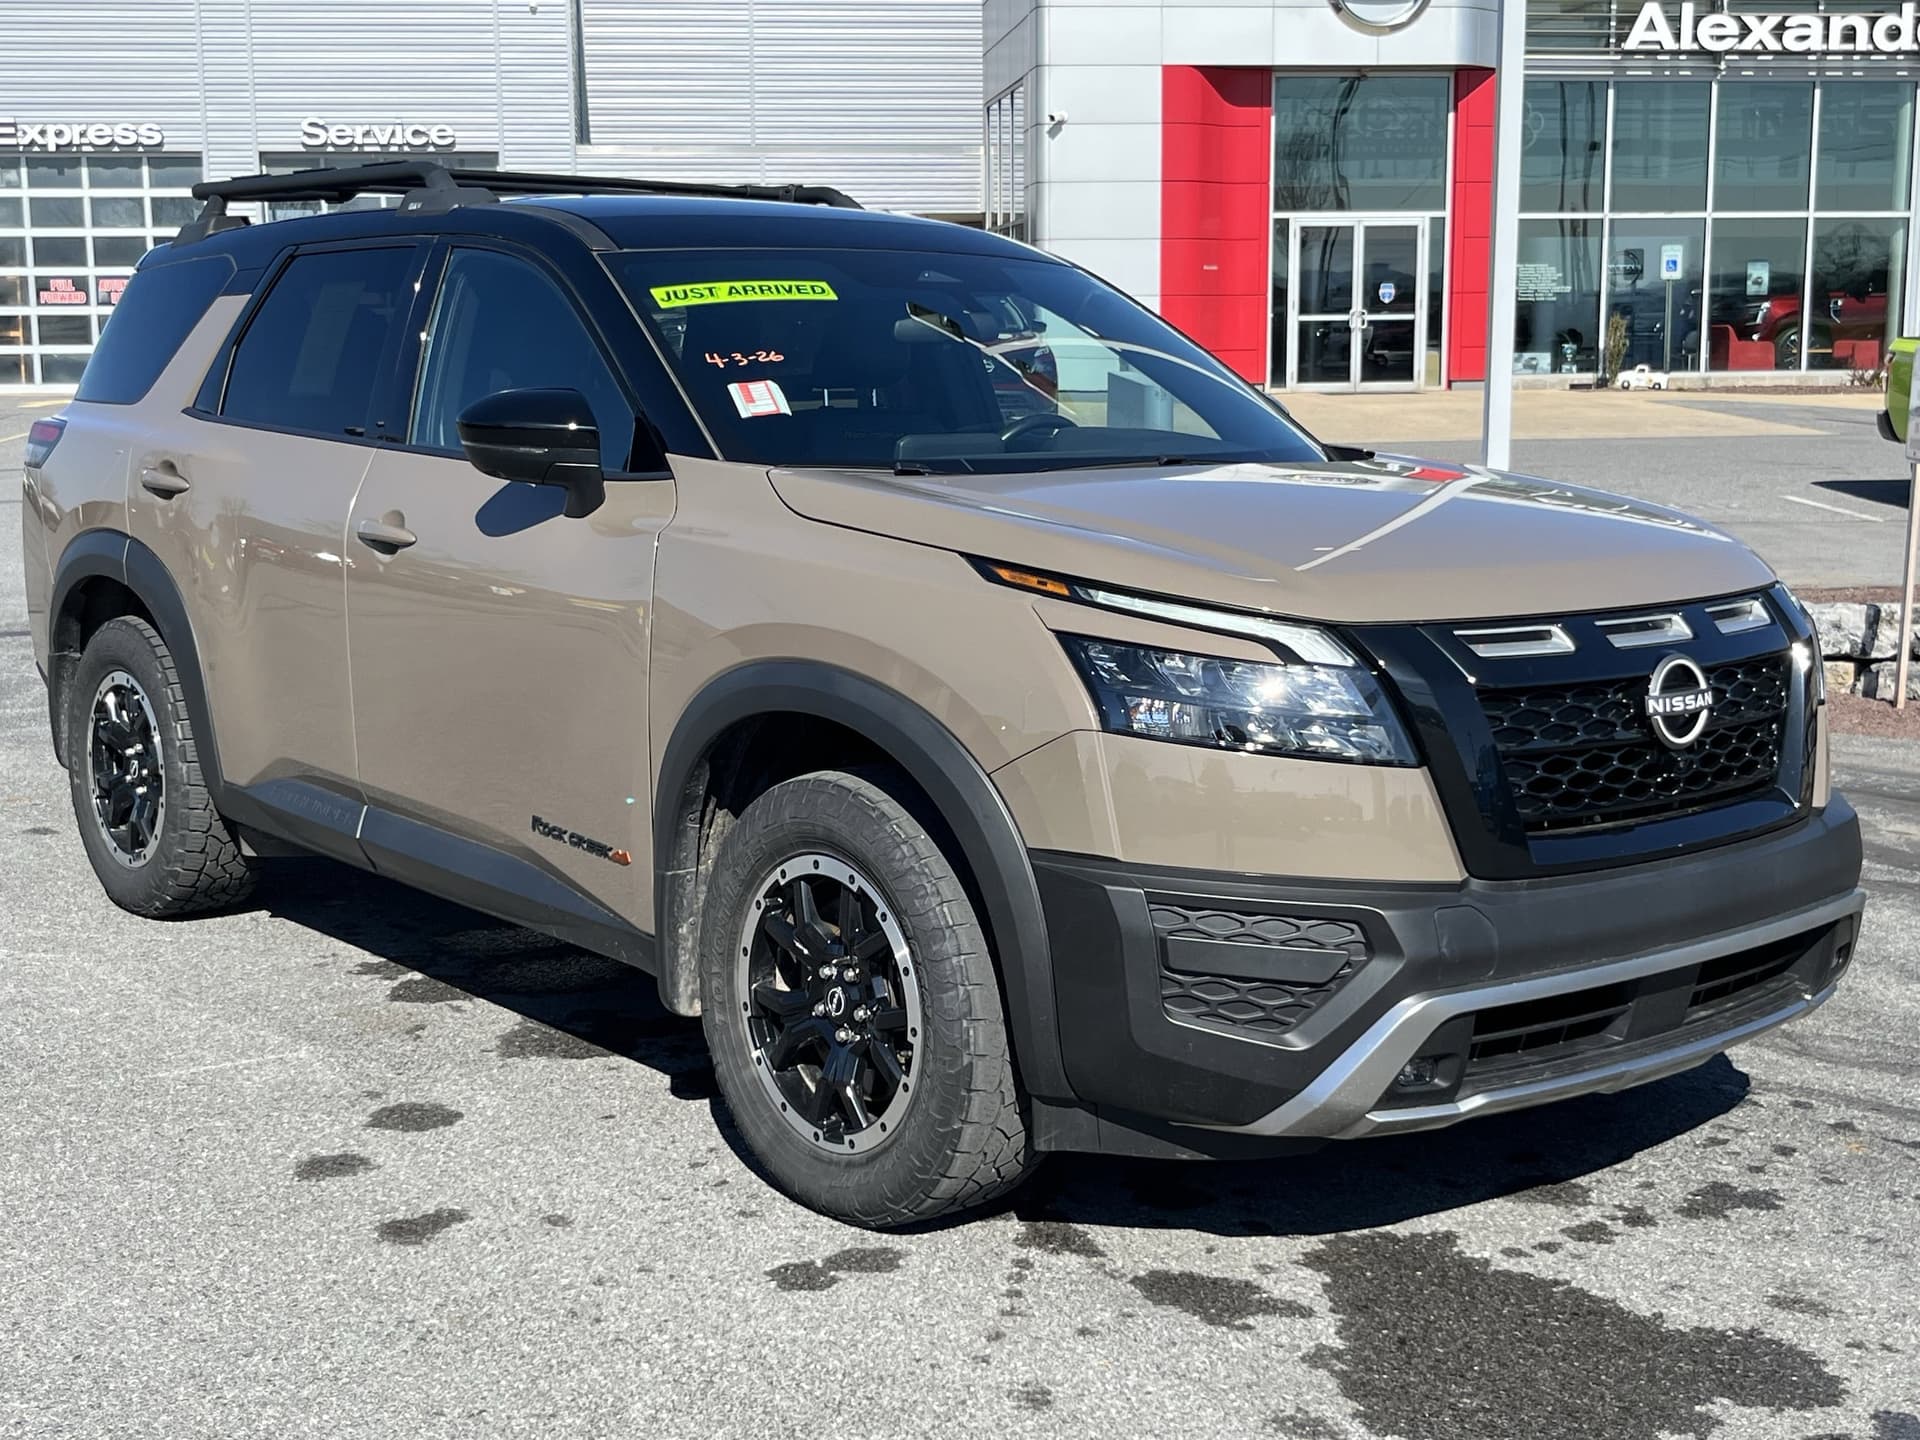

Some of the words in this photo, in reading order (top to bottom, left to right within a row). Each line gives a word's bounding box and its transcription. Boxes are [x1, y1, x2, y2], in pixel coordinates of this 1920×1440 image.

[1623, 1, 1920, 51] Alexand
[0, 116, 164, 152] Express
[301, 116, 456, 148] Service
[50, 279, 75, 291] PULL
[661, 287, 717, 302] JUST
[728, 284, 826, 297] ARRIVED
[40, 291, 87, 304] FORWARD
[704, 350, 785, 369] 4-3-26
[1647, 690, 1713, 714] NISSAN
